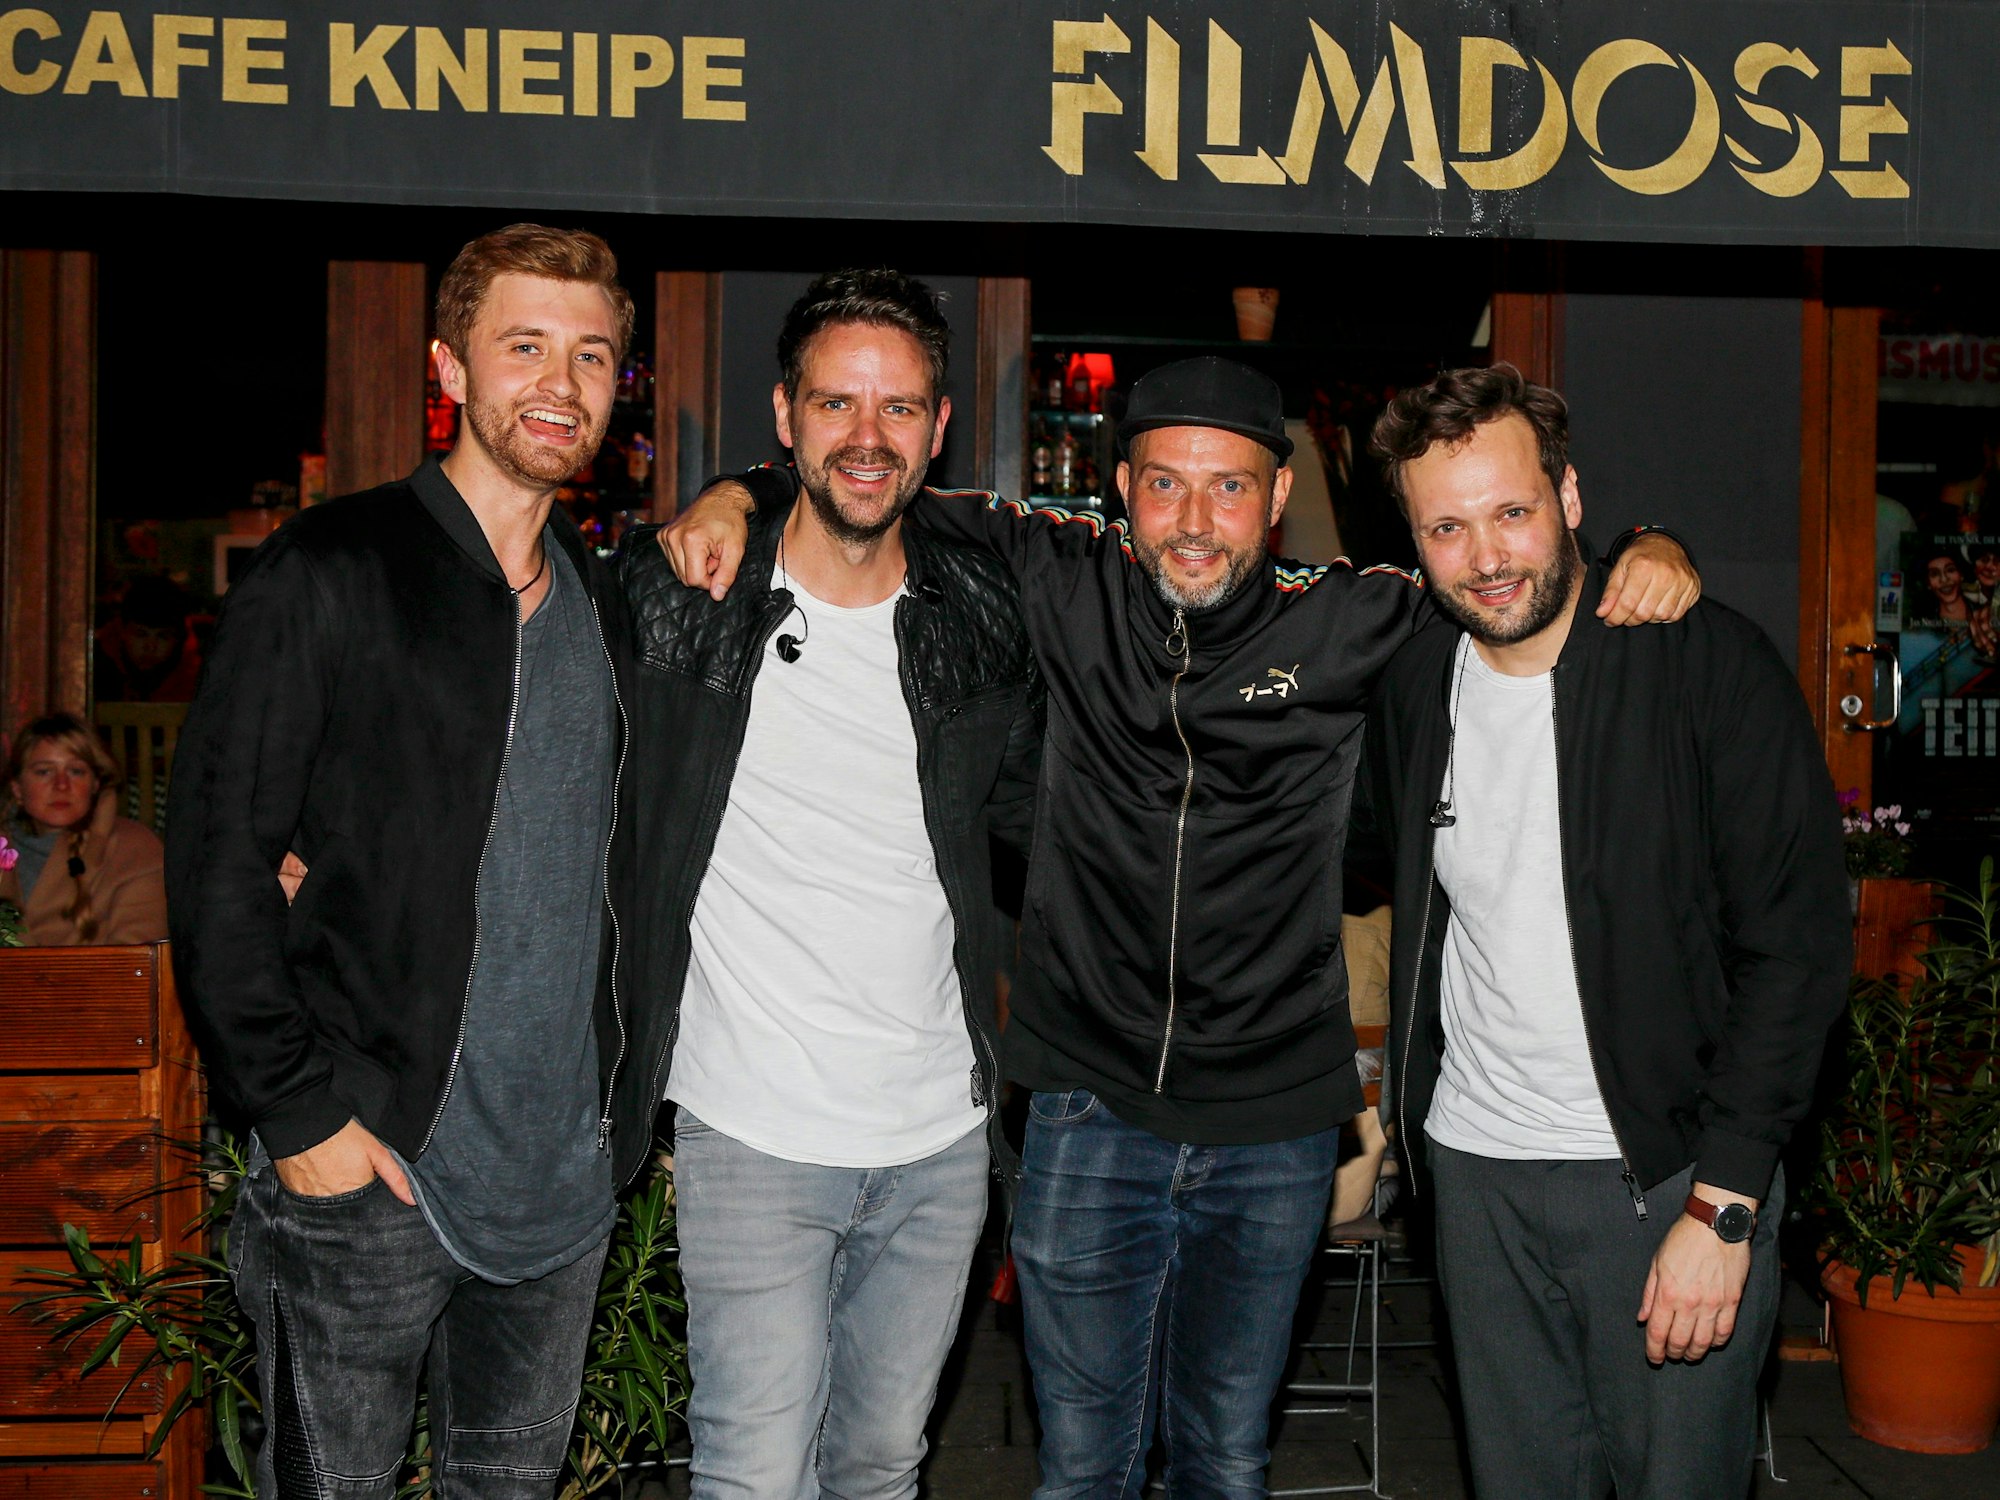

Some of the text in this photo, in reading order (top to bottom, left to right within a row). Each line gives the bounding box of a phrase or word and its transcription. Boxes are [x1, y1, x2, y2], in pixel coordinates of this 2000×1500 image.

[0, 8, 746, 121] CAFE KNEIPE
[1040, 12, 1912, 199] FILMDOSE
[1921, 698, 2000, 757] TEIT
